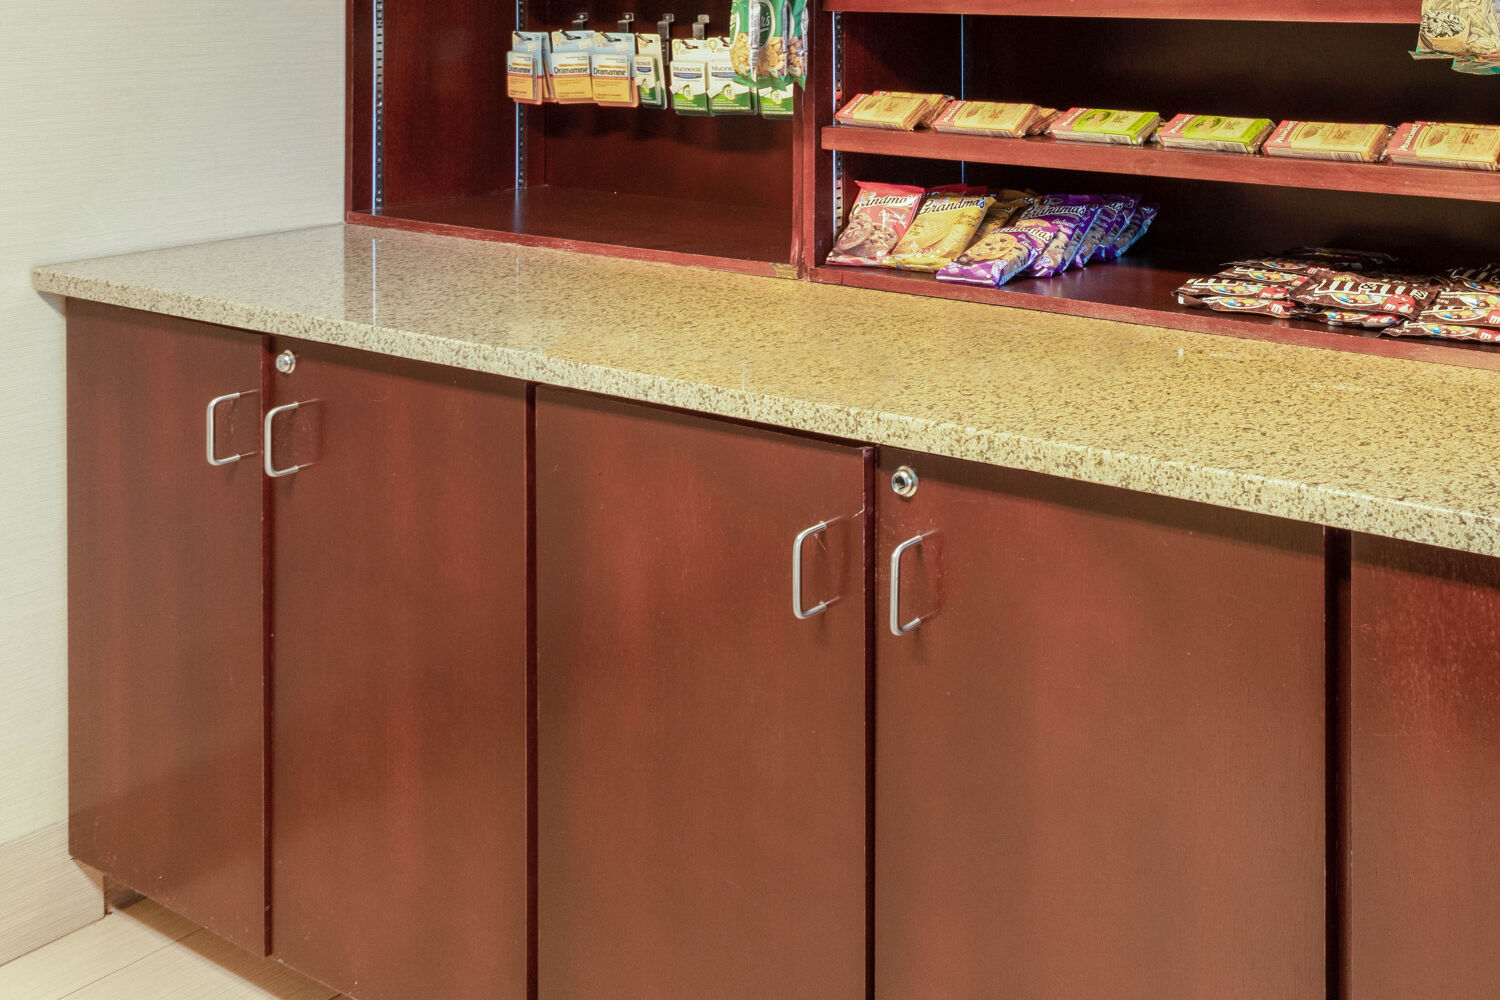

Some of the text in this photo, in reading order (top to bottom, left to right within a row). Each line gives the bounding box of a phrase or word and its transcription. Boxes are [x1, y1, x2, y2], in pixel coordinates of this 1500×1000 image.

[594, 68, 625, 76] Dramamine
[919, 198, 985, 215] Grandma's
[1022, 205, 1086, 219] Grandma's
